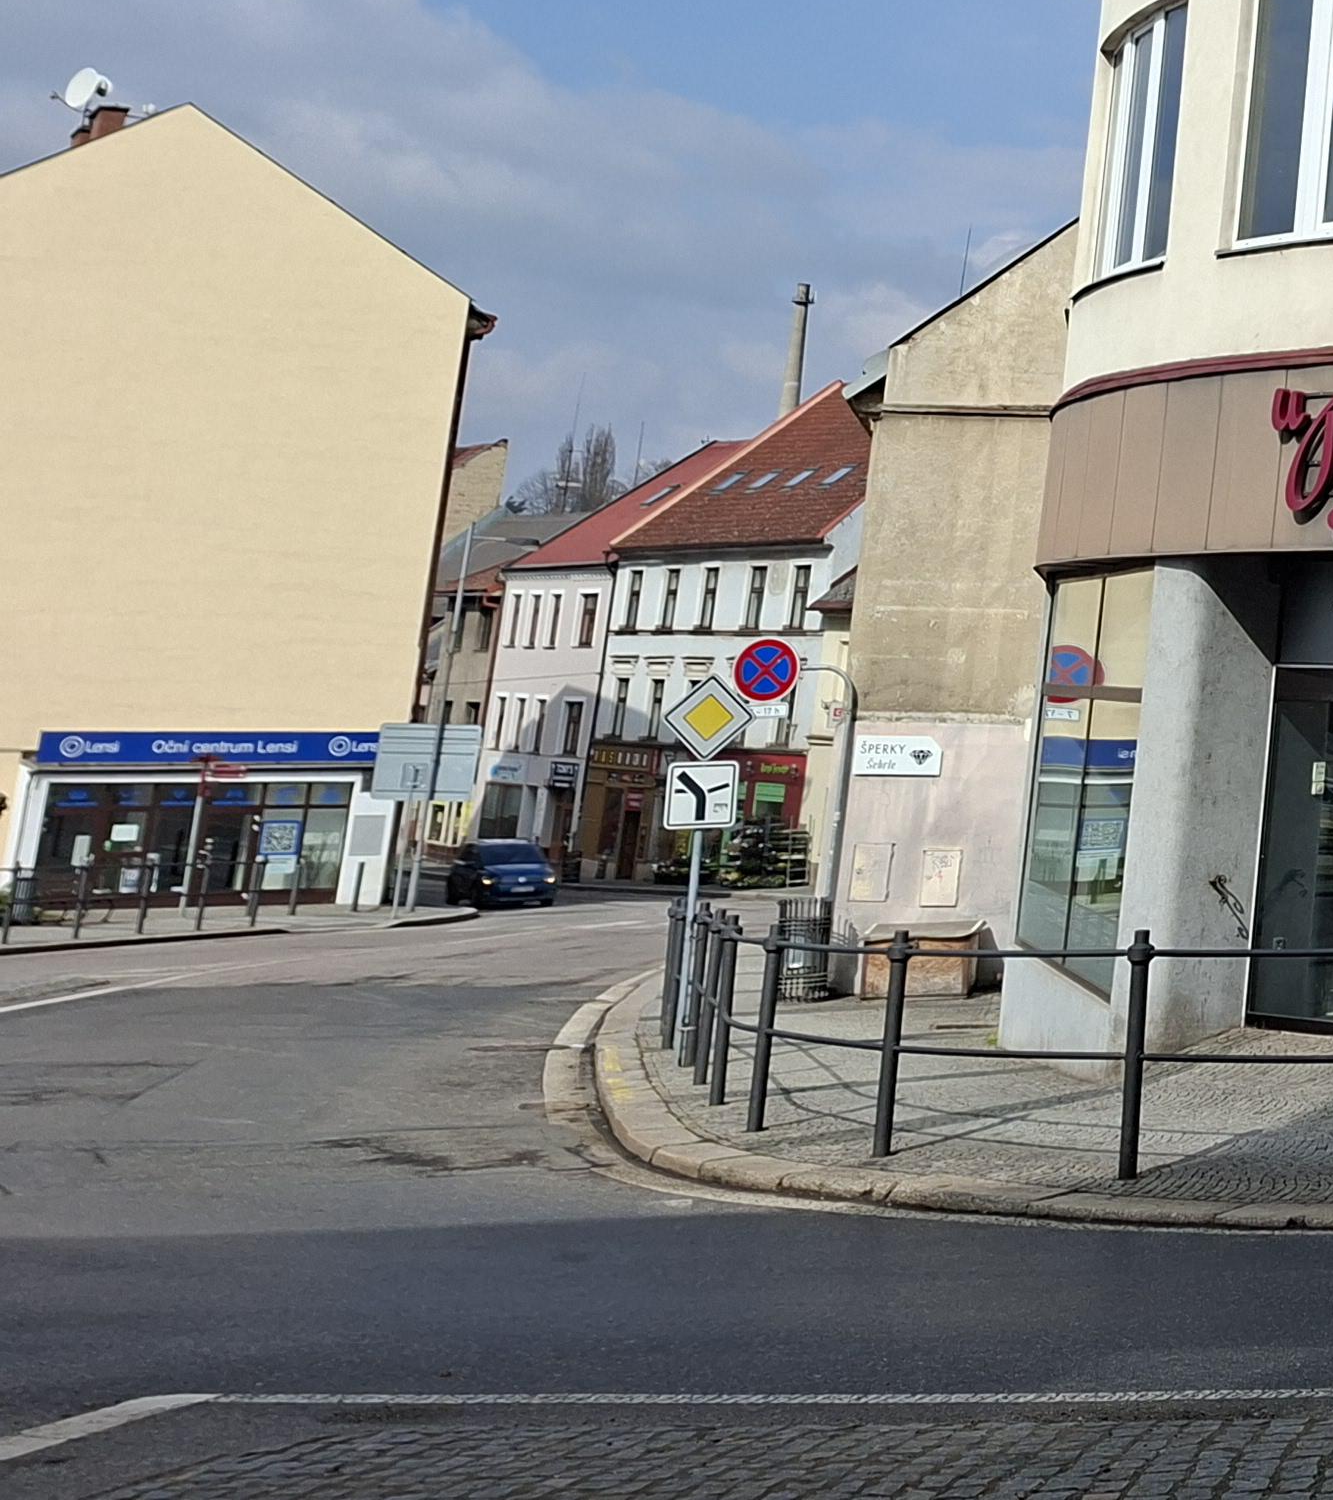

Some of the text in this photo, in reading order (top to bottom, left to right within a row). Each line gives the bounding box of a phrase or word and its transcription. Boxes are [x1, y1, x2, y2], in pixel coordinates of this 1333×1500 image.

[192, 740, 254, 753] centrum
[257, 740, 298, 754] Lensi
[351, 740, 379, 753] Lens
[860, 740, 906, 754] ŠPERKY
